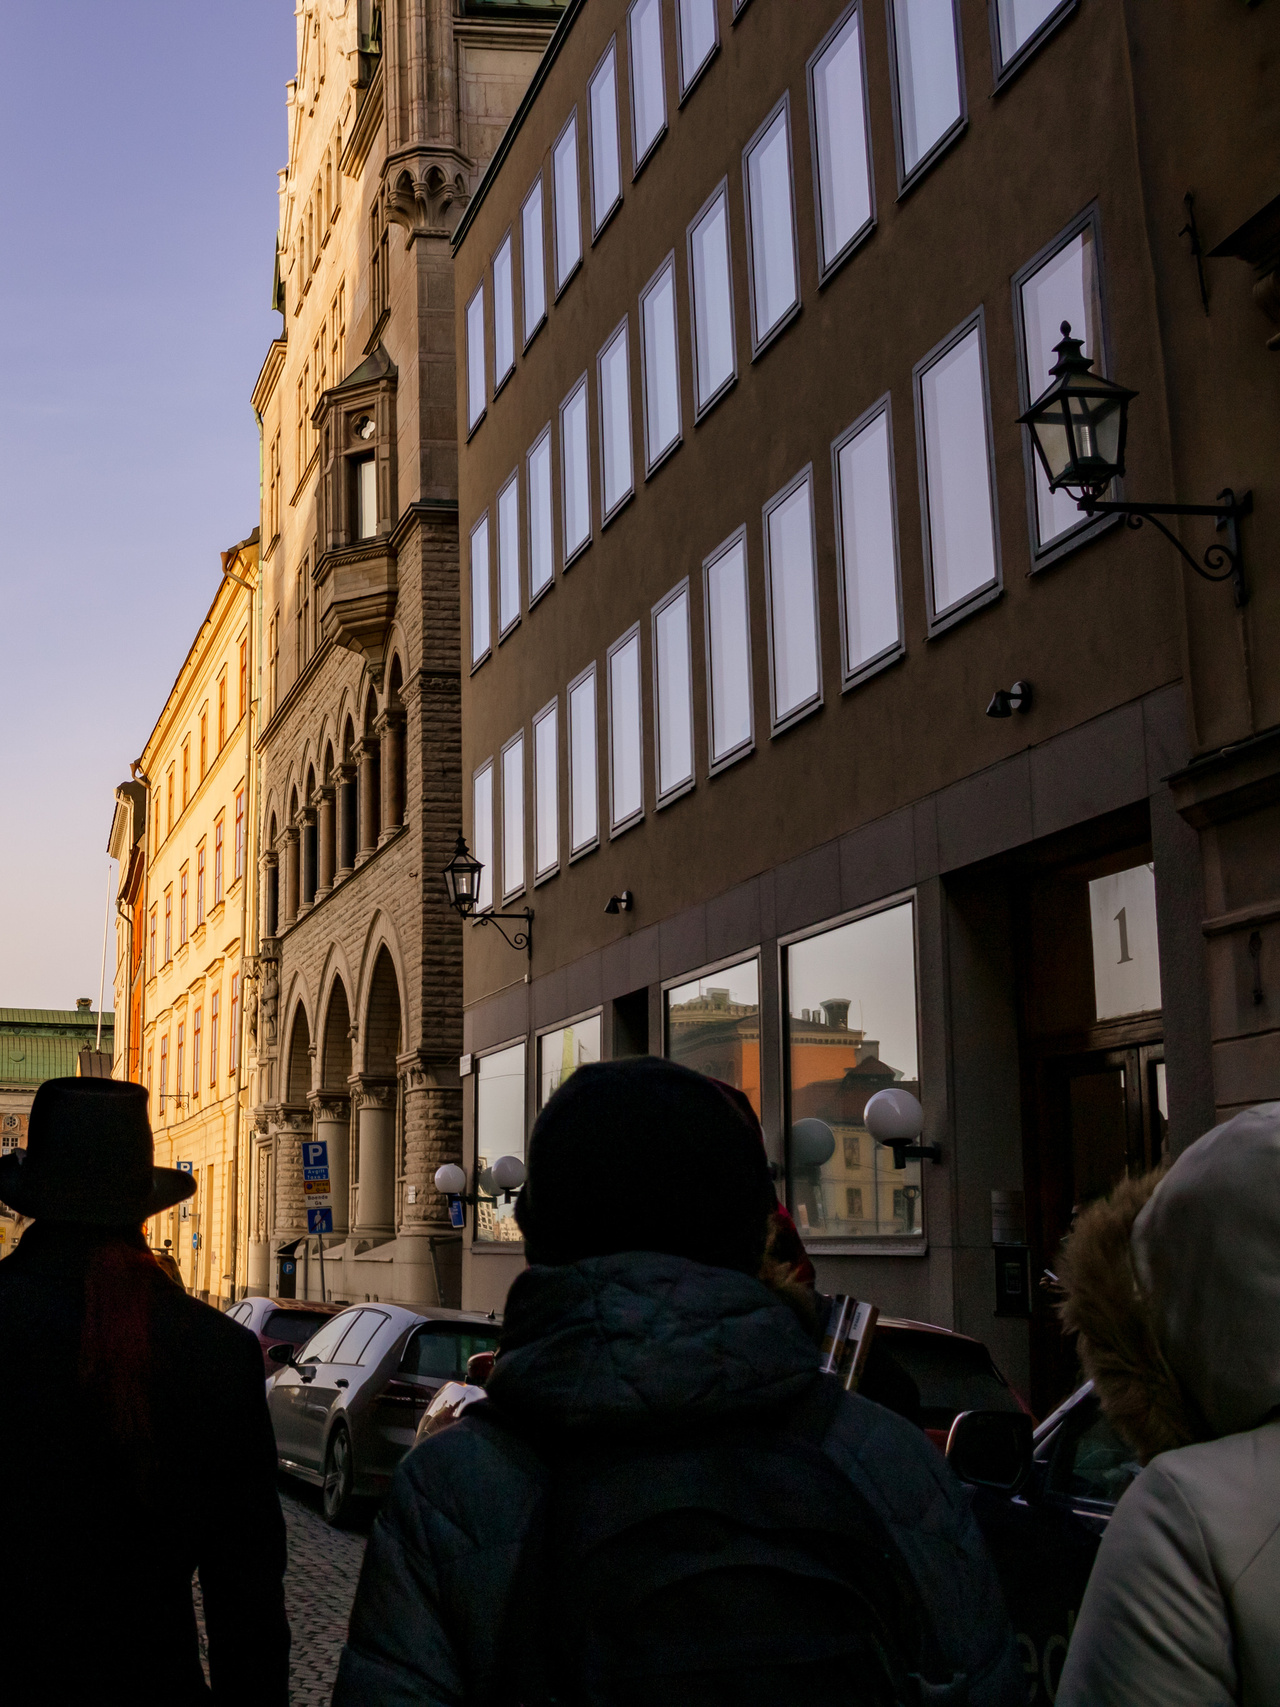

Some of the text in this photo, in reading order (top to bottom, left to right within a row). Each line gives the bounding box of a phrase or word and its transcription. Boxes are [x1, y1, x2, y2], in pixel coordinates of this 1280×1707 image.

[1113, 906, 1133, 965] 1
[308, 1144, 323, 1165] P
[286, 1264, 293, 1272] P
